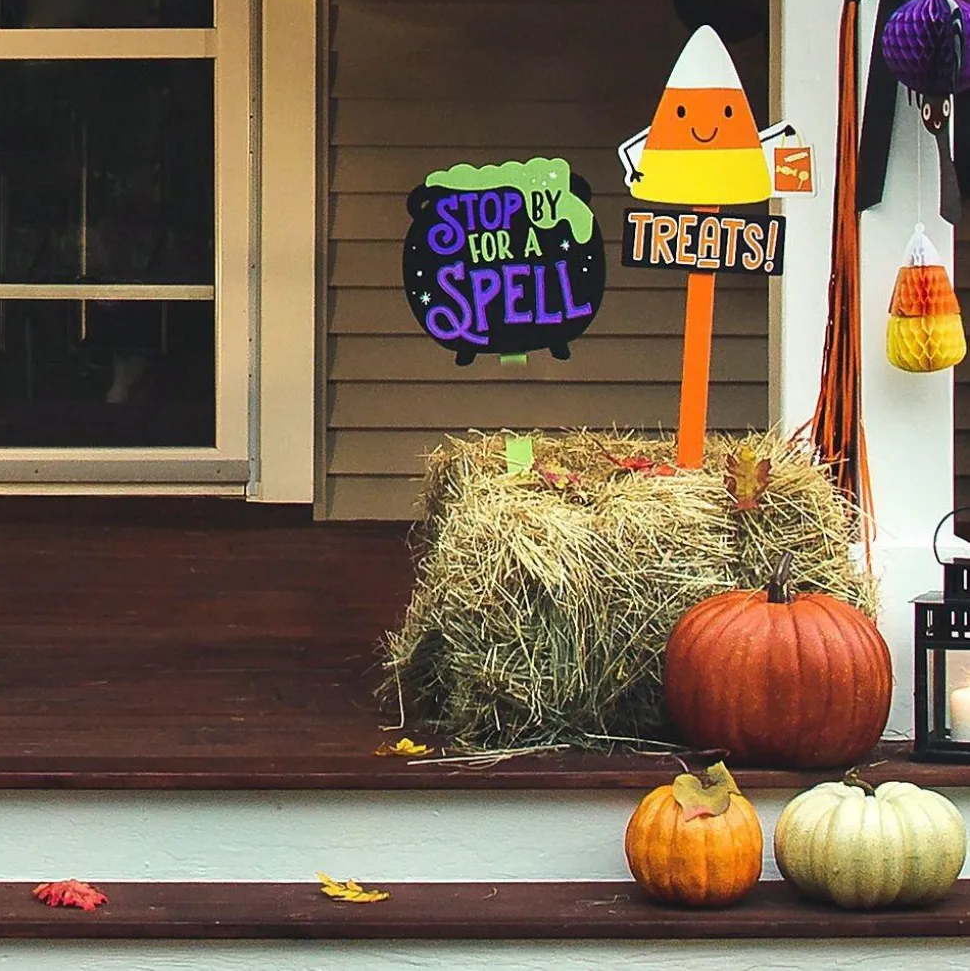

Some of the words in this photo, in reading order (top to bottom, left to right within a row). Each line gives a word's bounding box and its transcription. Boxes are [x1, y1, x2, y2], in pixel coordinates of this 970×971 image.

[427, 192, 523, 255] STOP
[531, 189, 562, 222] BY
[468, 230, 514, 264] FOR
[524, 227, 542, 257] A
[628, 213, 778, 272] TREATS!
[426, 259, 593, 345] SPELL
